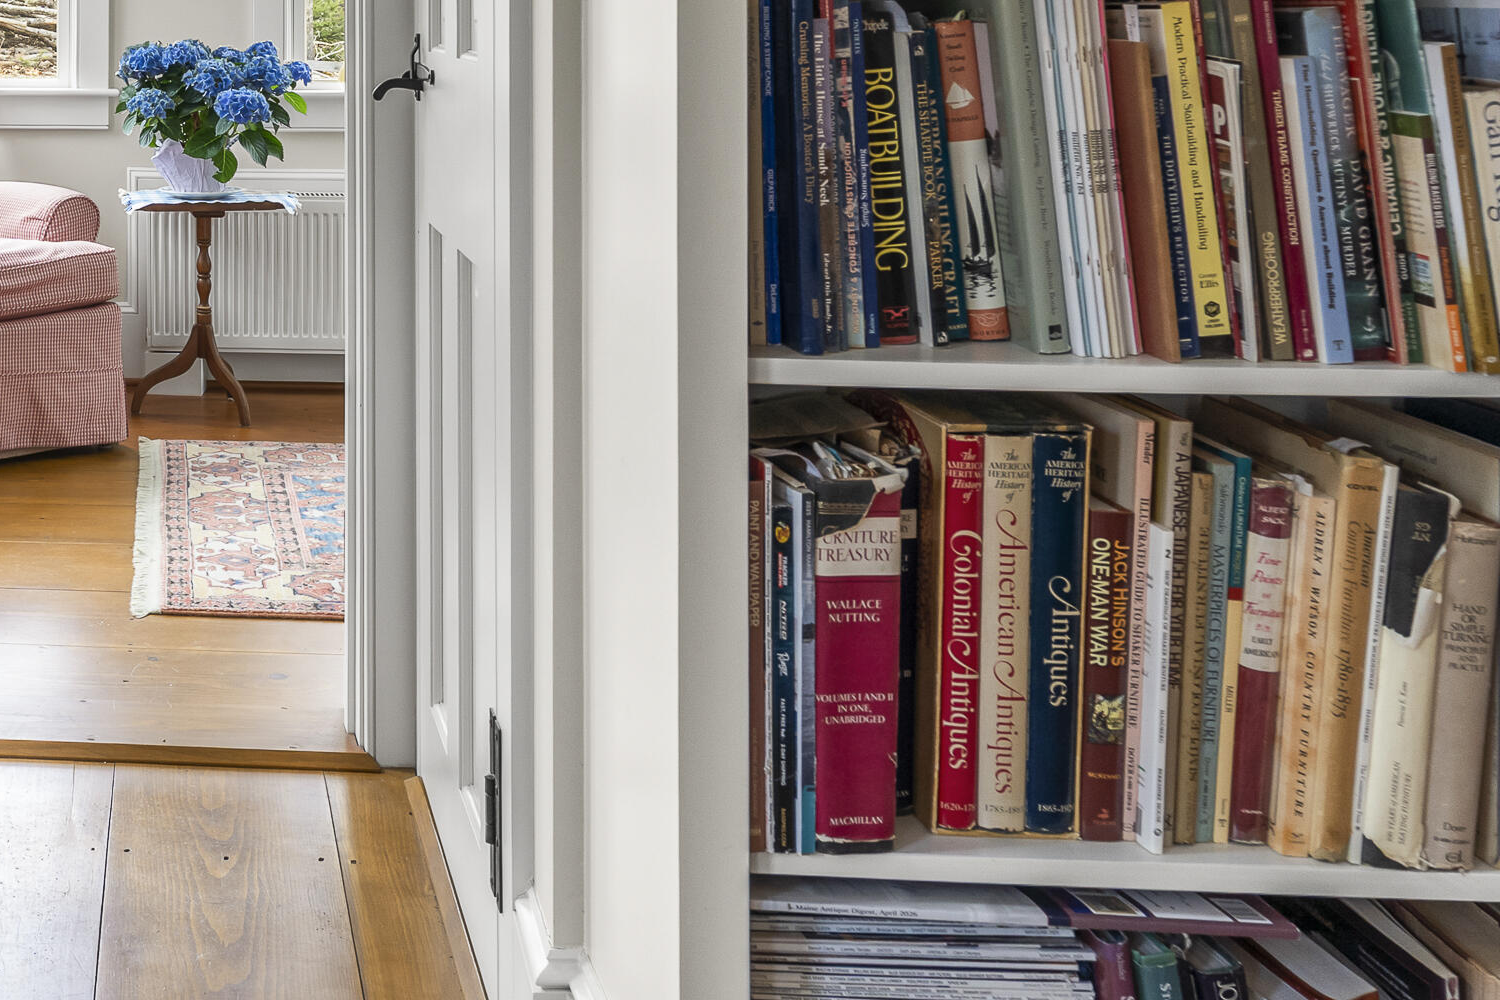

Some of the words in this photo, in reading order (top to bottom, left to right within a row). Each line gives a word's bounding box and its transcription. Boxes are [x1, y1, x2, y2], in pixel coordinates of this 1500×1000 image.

[797, 20, 811, 64] Cruising
[813, 32, 824, 54] The
[1171, 16, 1185, 54] Modern
[814, 57, 825, 87] Little
[916, 80, 928, 101] THE
[1176, 57, 1192, 100] Practical
[1300, 64, 1310, 83] Fine
[800, 67, 812, 121] Memories:
[815, 90, 826, 124] House
[1272, 90, 1284, 127] TIMBER
[803, 123, 813, 131] A
[817, 126, 827, 139] at
[918, 102, 933, 163] SHARPIE
[1182, 103, 1198, 167] Stairbuilding
[1302, 85, 1317, 147] Homebuilding
[803, 133, 815, 172] Boater's
[817, 142, 829, 176] Sandy
[1276, 130, 1289, 165] FRAME
[767, 168, 776, 212] GILPATRICK
[803, 174, 816, 204] Diary
[859, 149, 869, 200] Stonescaping
[869, 67, 909, 272] BOATBUILDING
[923, 166, 937, 200] BOOK
[1189, 169, 1202, 189] and
[1310, 149, 1324, 194] Questions
[1322, 83, 1341, 153] SHIPWRECK,
[1332, 158, 1348, 208] MUTINY
[1341, 226, 1357, 278] MURDER
[1349, 158, 1368, 219] DAVID
[819, 179, 830, 207] Neck
[1280, 167, 1300, 245] CONSTRUCTION
[861, 201, 870, 228] Simple
[1163, 135, 1173, 158] THE
[1174, 236, 1189, 303] REFLECTION
[1192, 192, 1210, 250] Handrailing
[1316, 205, 1329, 243] Answers
[929, 240, 944, 290] PARKER
[1322, 245, 1334, 270] about
[1358, 225, 1379, 298] GRANN
[1262, 231, 1288, 345] WEATHERPROOFING
[1323, 272, 1338, 310] Building
[1141, 432, 1155, 464] Meader
[750, 500, 760, 531] PAINT
[1134, 497, 1150, 567] ILLUSTRATED
[750, 533, 760, 560] AND
[818, 546, 893, 562] TREASURY
[1113, 539, 1130, 582] JACK
[1359, 522, 1376, 588] American
[750, 562, 760, 627] WALLPAPER
[949, 529, 983, 639] Colonial
[995, 509, 1030, 658] American
[1090, 537, 1111, 620] ONE-MAN
[1134, 570, 1146, 604] GUIDE
[1207, 543, 1226, 643] MASTERPIECES
[826, 599, 882, 610] WALLACE
[828, 612, 880, 623] NUTTING
[1134, 606, 1145, 622] TO
[1044, 575, 1079, 707] Antiques
[1089, 625, 1107, 667] WAR
[1111, 587, 1128, 667] HINSON'S
[1130, 624, 1145, 665] SHAKER
[1207, 645, 1221, 666] OF
[942, 633, 981, 770] Antiques
[1127, 669, 1141, 729] FURNITURE
[1202, 670, 1221, 745] FURNITURE
[1224, 685, 1235, 713] MILLER
[1300, 651, 1316, 722] COUNTRY
[825, 715, 886, 725] UNABRIDGED
[986, 658, 1026, 794] Antiques
[1292, 729, 1311, 818] FURNITURE
[829, 816, 883, 826] MACMILLAN
[795, 904, 818, 913] Maine
[819, 905, 849, 915] Antique
[851, 907, 877, 917] Digest,
[879, 909, 898, 918] April
